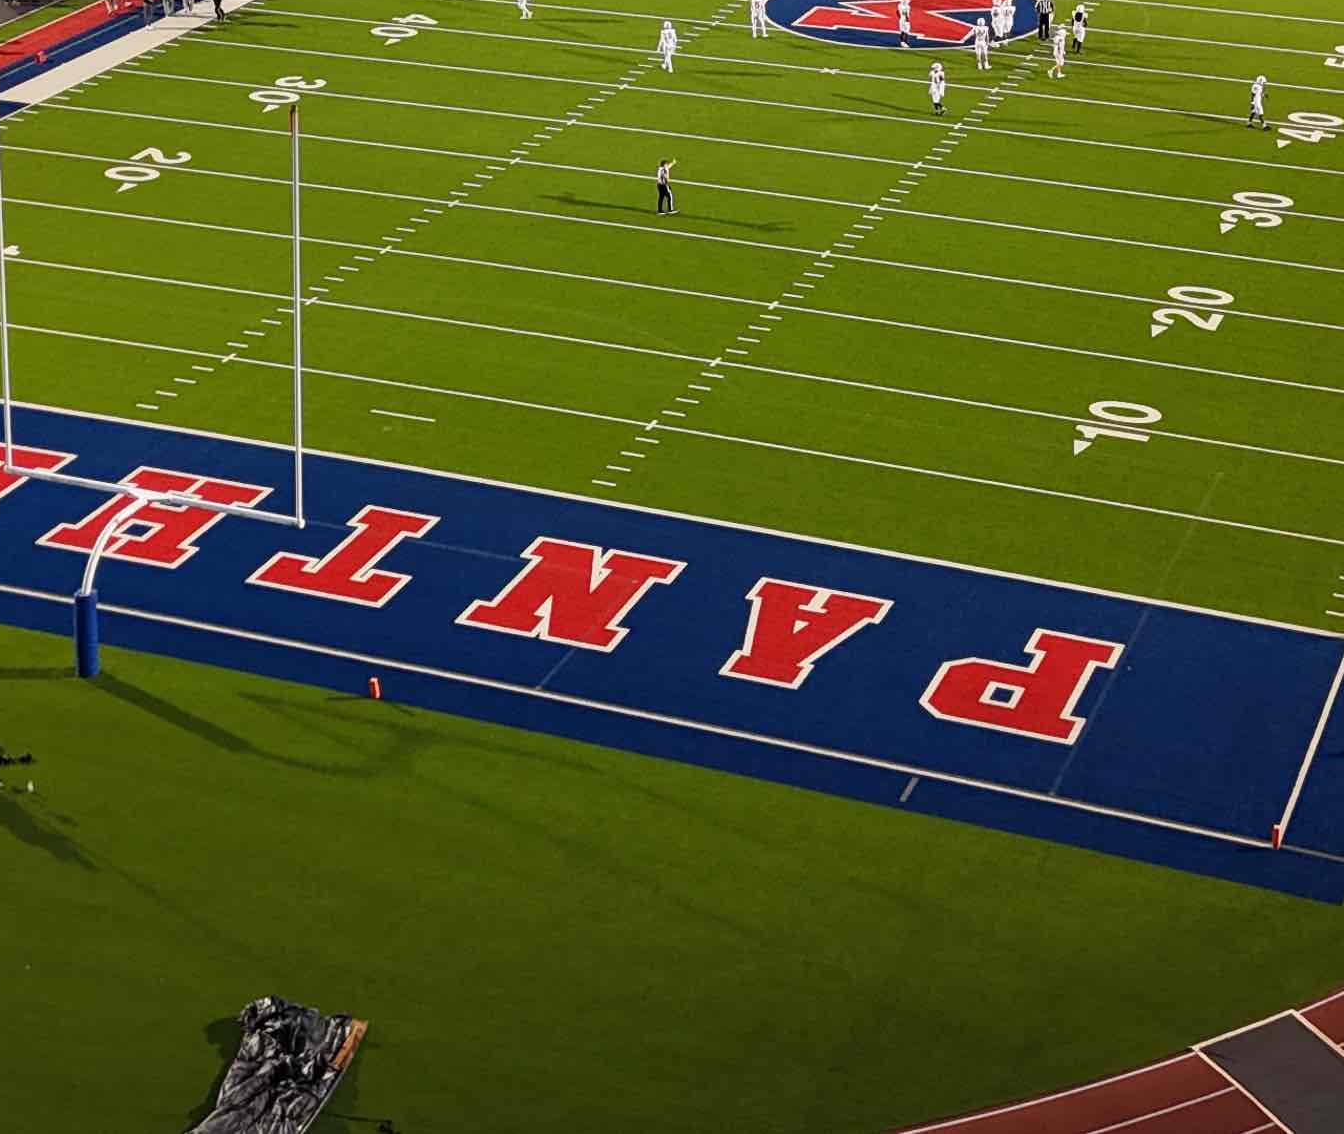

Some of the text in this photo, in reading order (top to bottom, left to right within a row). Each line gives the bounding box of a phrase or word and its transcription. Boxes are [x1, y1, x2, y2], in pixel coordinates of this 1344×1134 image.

[369, 13, 439, 39] 40
[248, 75, 327, 105] 30
[103, 146, 193, 183] 20
[1219, 191, 1296, 228] 30
[1151, 284, 1236, 332] 20
[1075, 399, 1164, 443] 10
